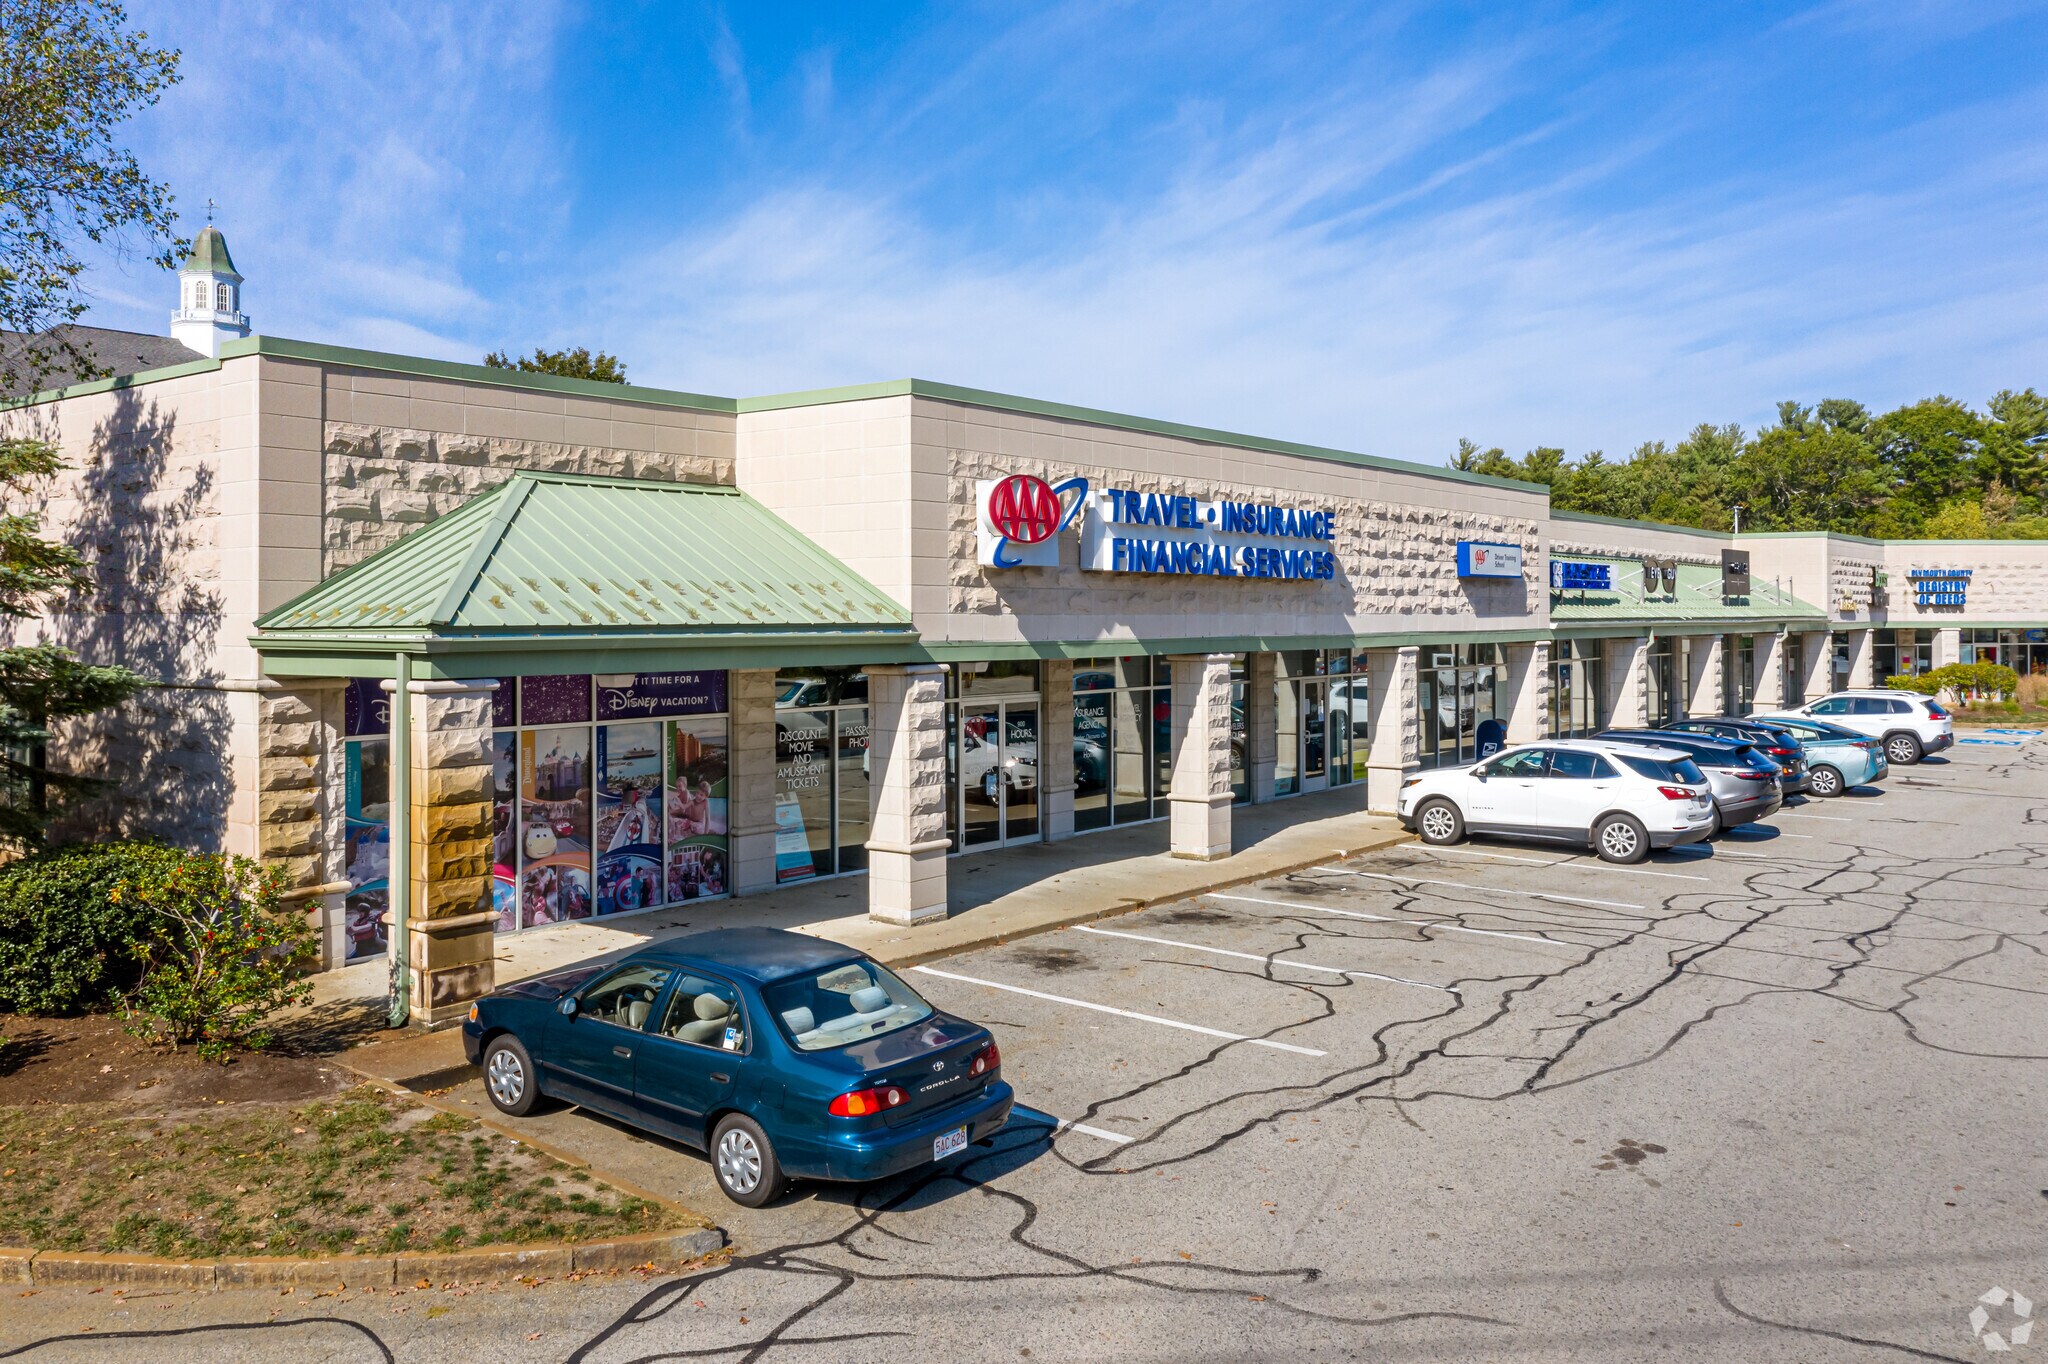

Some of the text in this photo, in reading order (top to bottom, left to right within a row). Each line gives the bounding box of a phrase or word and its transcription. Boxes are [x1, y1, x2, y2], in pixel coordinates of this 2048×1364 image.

[990, 476, 1058, 543] AAA
[1108, 489, 1335, 540] TRAVEL INSURANCE
[1112, 538, 1334, 580] FINANCIAL SERVICES
[1919, 581, 1967, 592] REGISTRY
[1920, 594, 1966, 605] OF DEEDS
[641, 677, 649, 685] IT
[652, 676, 673, 685] TIME
[675, 676, 692, 684] FOR
[694, 675, 700, 683] A
[660, 696, 709, 706] VACATION?
[1073, 707, 1104, 717] NSURANCE
[779, 729, 822, 742] DISCOUNT
[1010, 729, 1032, 739] HOURS
[789, 741, 814, 753] MOVIE
[849, 737, 869, 748] PHOT
[792, 754, 812, 764] AND
[523, 747, 531, 784] Disneyland
[777, 764, 826, 778] AMUSEMENT
[786, 777, 819, 789] TICKETS
[920, 1075, 960, 1092] COROLLA
[952, 1131, 965, 1147] 628
